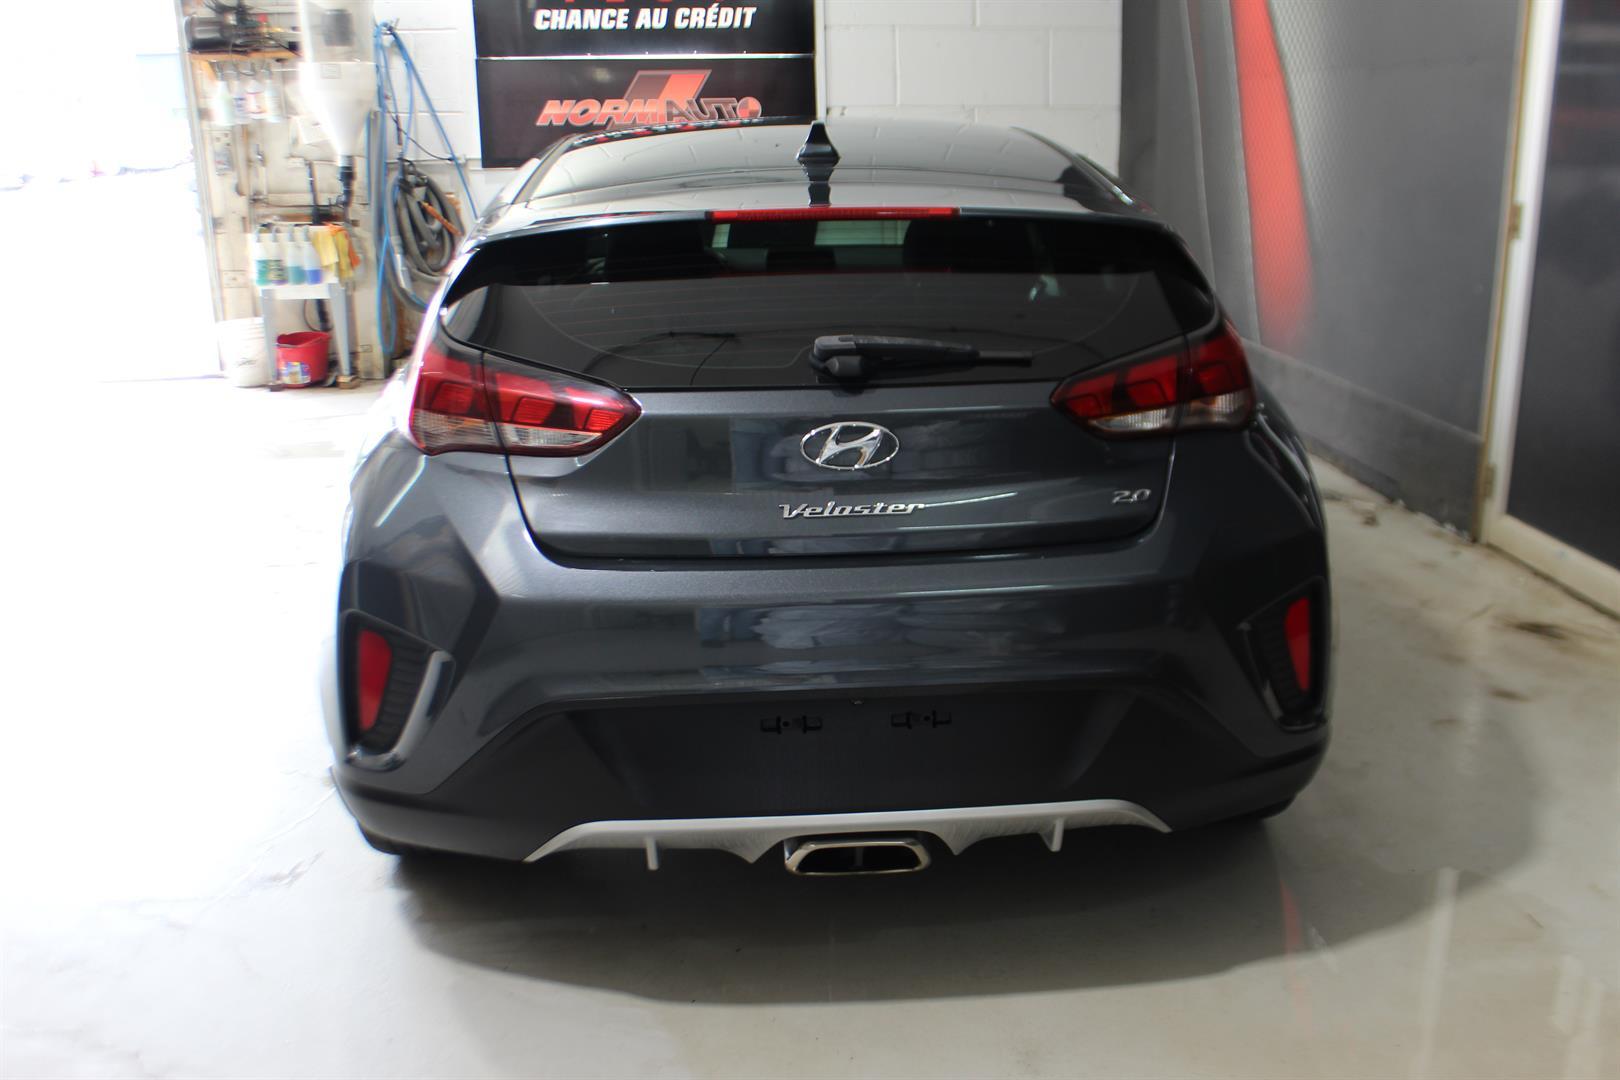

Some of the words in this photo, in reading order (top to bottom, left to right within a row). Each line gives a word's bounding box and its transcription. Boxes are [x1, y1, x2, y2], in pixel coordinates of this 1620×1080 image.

[534, 9, 629, 30] CHANCE
[635, 8, 668, 29] AU
[674, 3, 757, 29] CRÉDIT
[779, 501, 926, 519] Veloster
